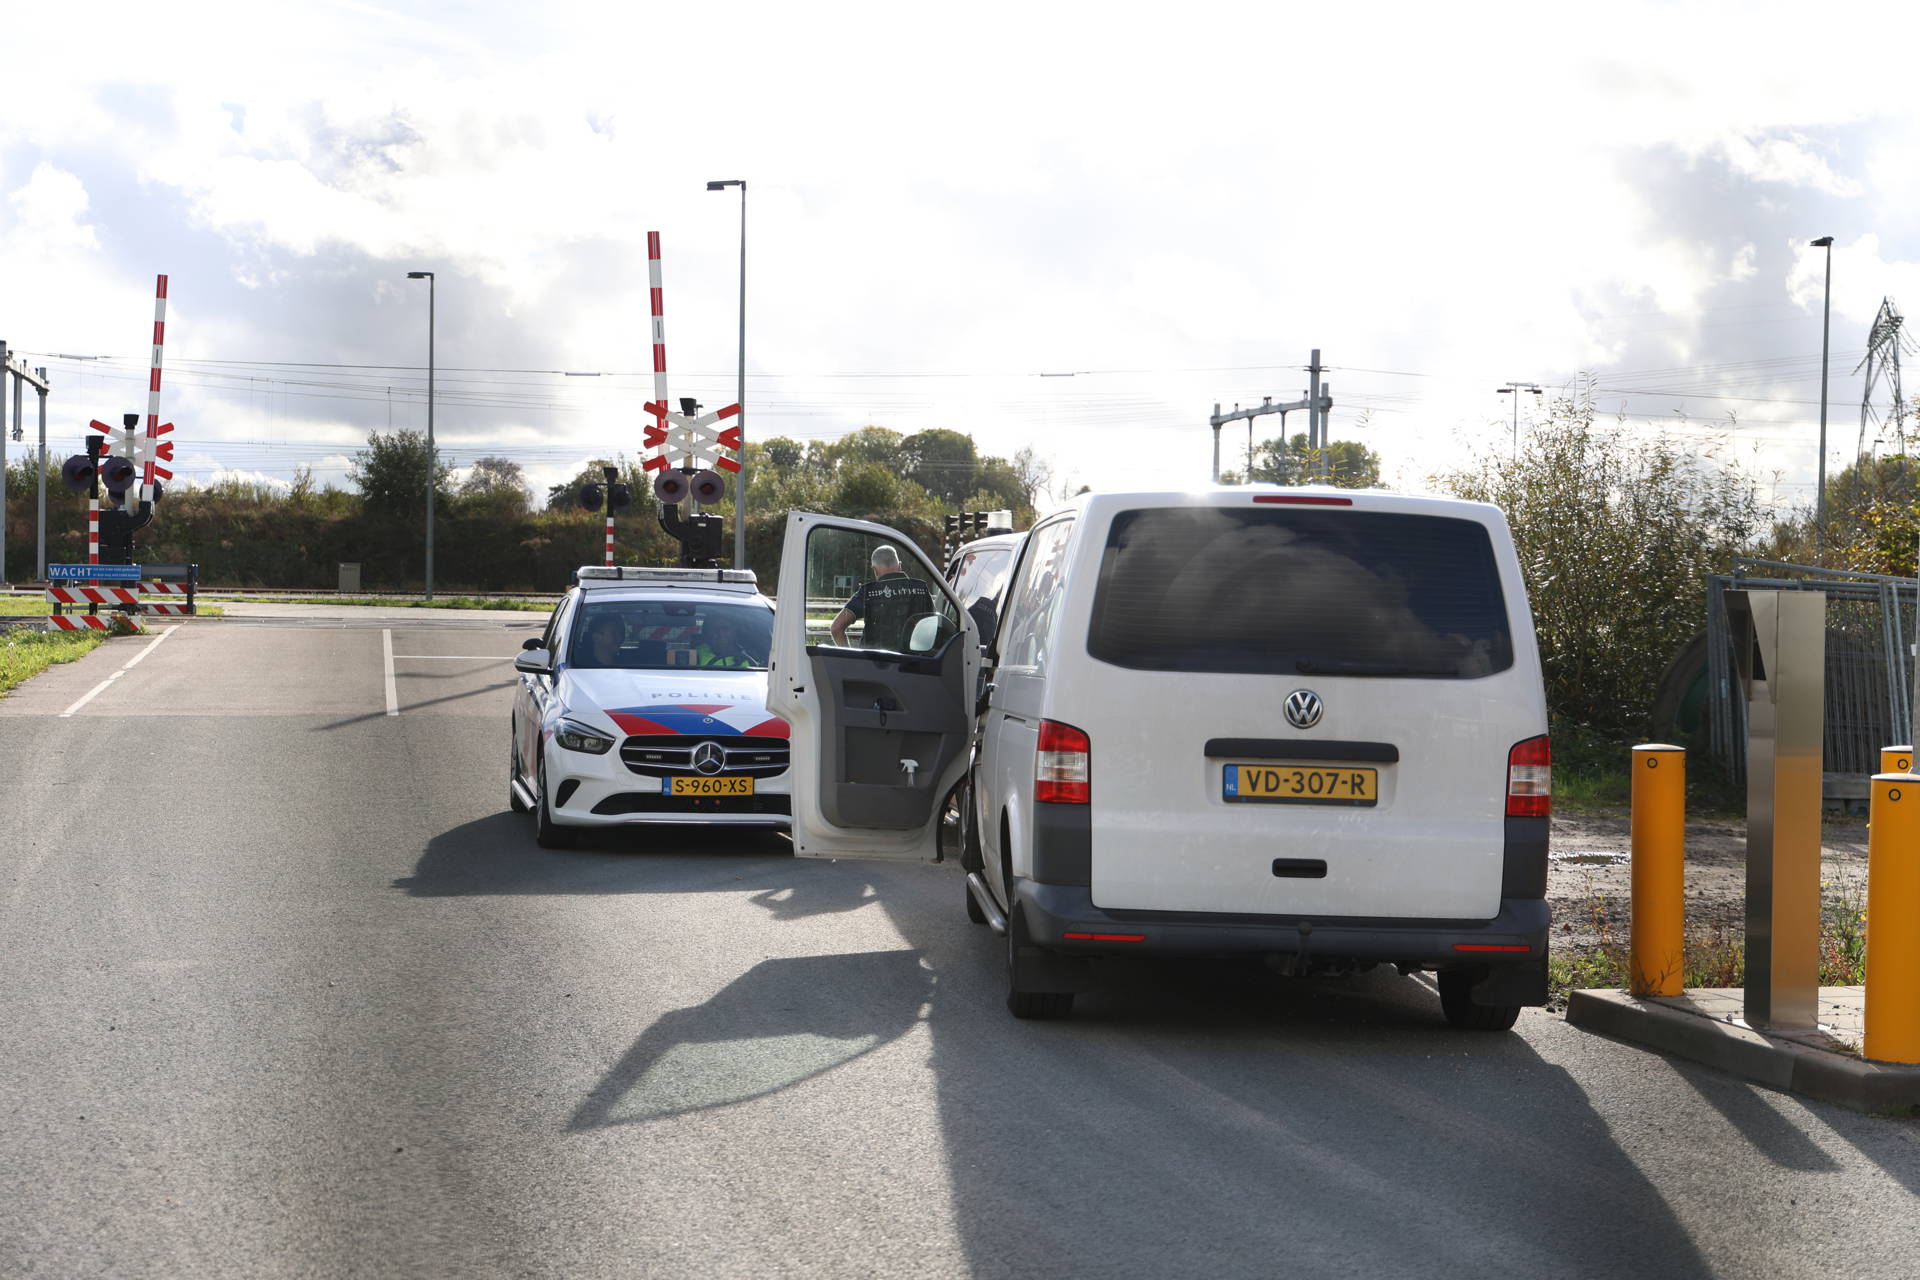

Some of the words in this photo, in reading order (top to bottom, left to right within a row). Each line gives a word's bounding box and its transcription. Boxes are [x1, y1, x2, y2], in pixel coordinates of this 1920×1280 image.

[50, 567, 93, 577] WACHT
[651, 692, 752, 700] POLITIE
[675, 779, 747, 792] S-960-XS
[1226, 783, 1237, 791] NL
[1247, 770, 1366, 795] VD-307-R
